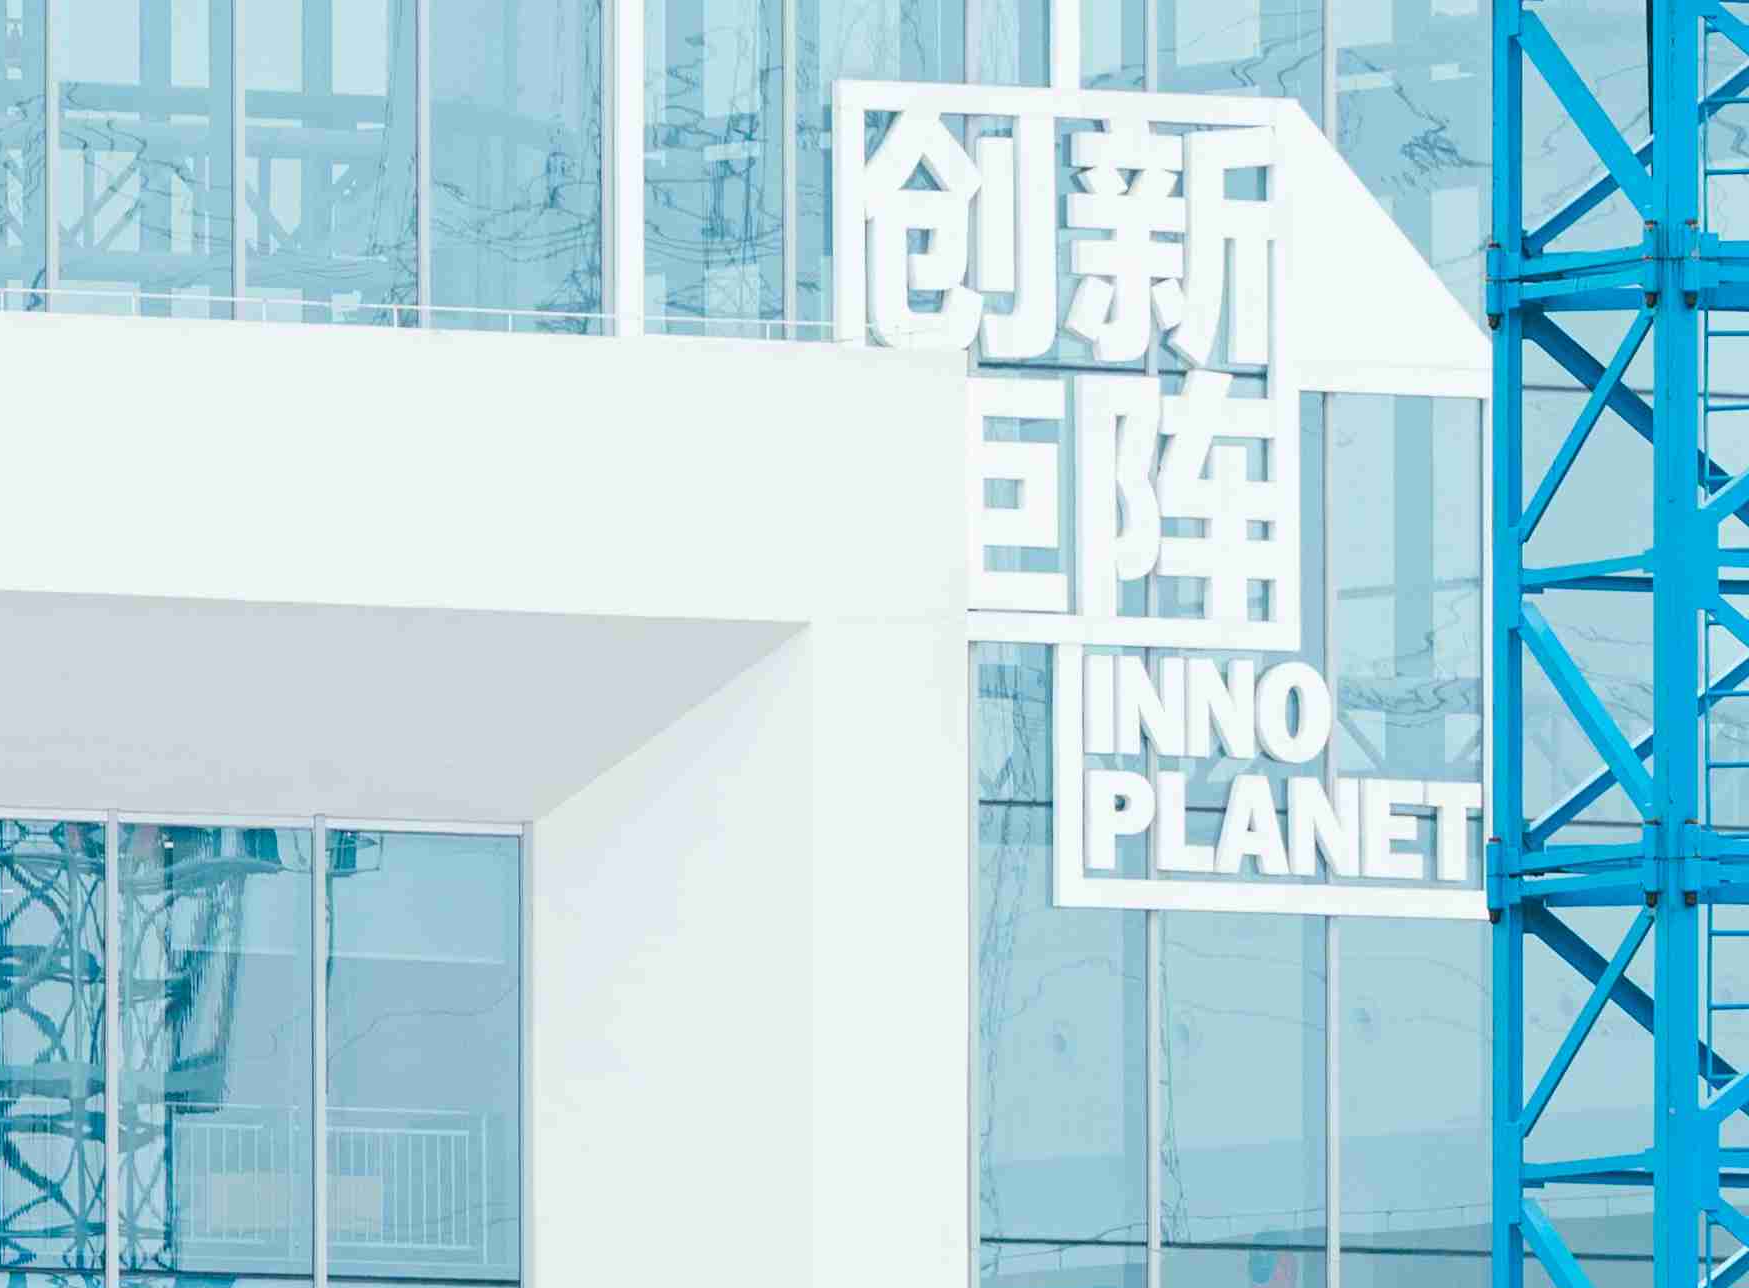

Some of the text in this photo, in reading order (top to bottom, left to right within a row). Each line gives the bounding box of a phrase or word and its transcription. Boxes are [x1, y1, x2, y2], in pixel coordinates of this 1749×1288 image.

[864, 108, 1276, 370] 创新
[1083, 652, 1333, 764] INNO
[1083, 768, 1484, 882] PLANET
